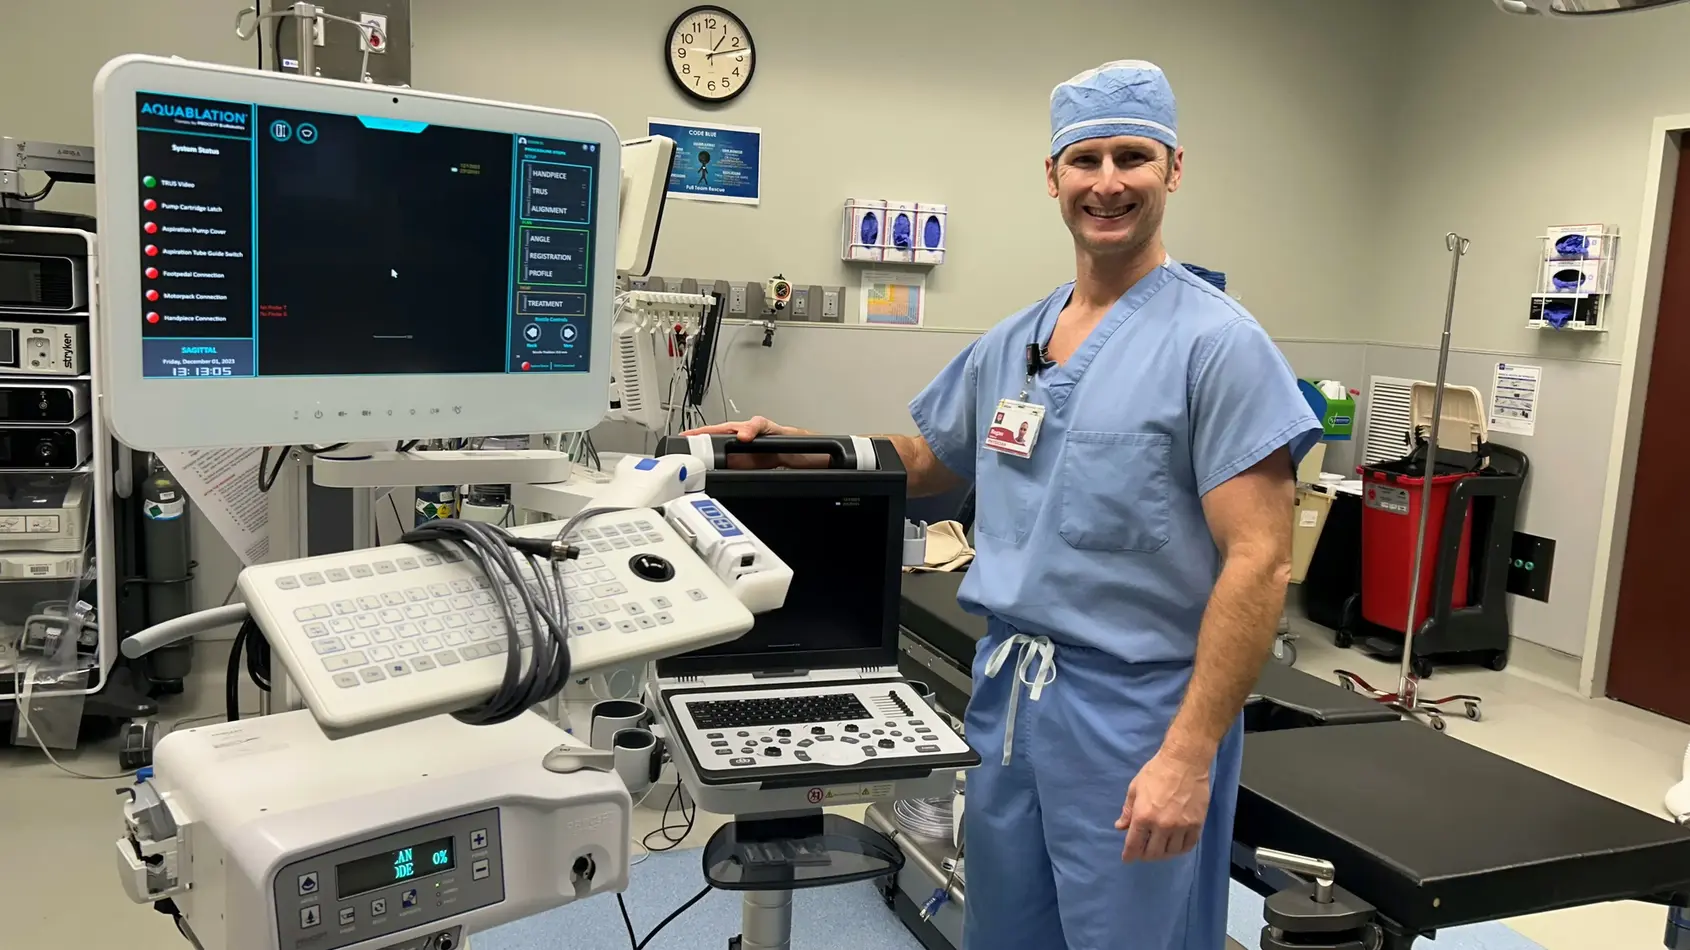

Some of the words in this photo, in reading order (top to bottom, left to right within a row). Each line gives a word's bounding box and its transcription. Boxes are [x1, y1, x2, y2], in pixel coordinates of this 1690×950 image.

[692, 22, 701, 33] 11
[705, 18, 717, 30] 12
[723, 24, 727, 35] 1
[681, 33, 694, 45] 10
[731, 37, 740, 48] 2
[677, 47, 687, 59] 9
[682, 63, 691, 74] 8
[731, 67, 740, 77] 4
[693, 75, 701, 86] 7
[707, 80, 716, 91] 6
[721, 77, 730, 88] 5
[141, 102, 245, 124] AQUABLATION
[688, 129, 705, 137] CODE
[171, 143, 198, 154] System
[198, 145, 220, 155] Status
[532, 170, 567, 180] HANDPIECE
[161, 179, 177, 188] TRUS
[178, 180, 195, 189] Video
[532, 187, 548, 195] TRUS
[161, 202, 179, 211] Pump
[180, 203, 207, 212] Cartridge
[207, 204, 223, 213] Latch
[531, 205, 568, 214] ALIGNMENT
[162, 225, 192, 234] Aspiration
[192, 227, 210, 235] Pump
[530, 235, 550, 243] ANGLE
[162, 248, 192, 256] Aspiration
[225, 250, 244, 258] Switch
[529, 252, 572, 261] REGISTRATION
[163, 270, 193, 278] Footpedal
[193, 271, 225, 279] Connection
[529, 269, 553, 278] PROFILE
[163, 292, 195, 300] Motorpack
[528, 300, 564, 308] TREATMENT
[164, 315, 195, 323] Handpiece
[62, 333, 74, 369] stryker
[181, 346, 218, 354] SAGITTAL
[162, 358, 182, 366] Friday,
[432, 849, 448, 865] 0%
